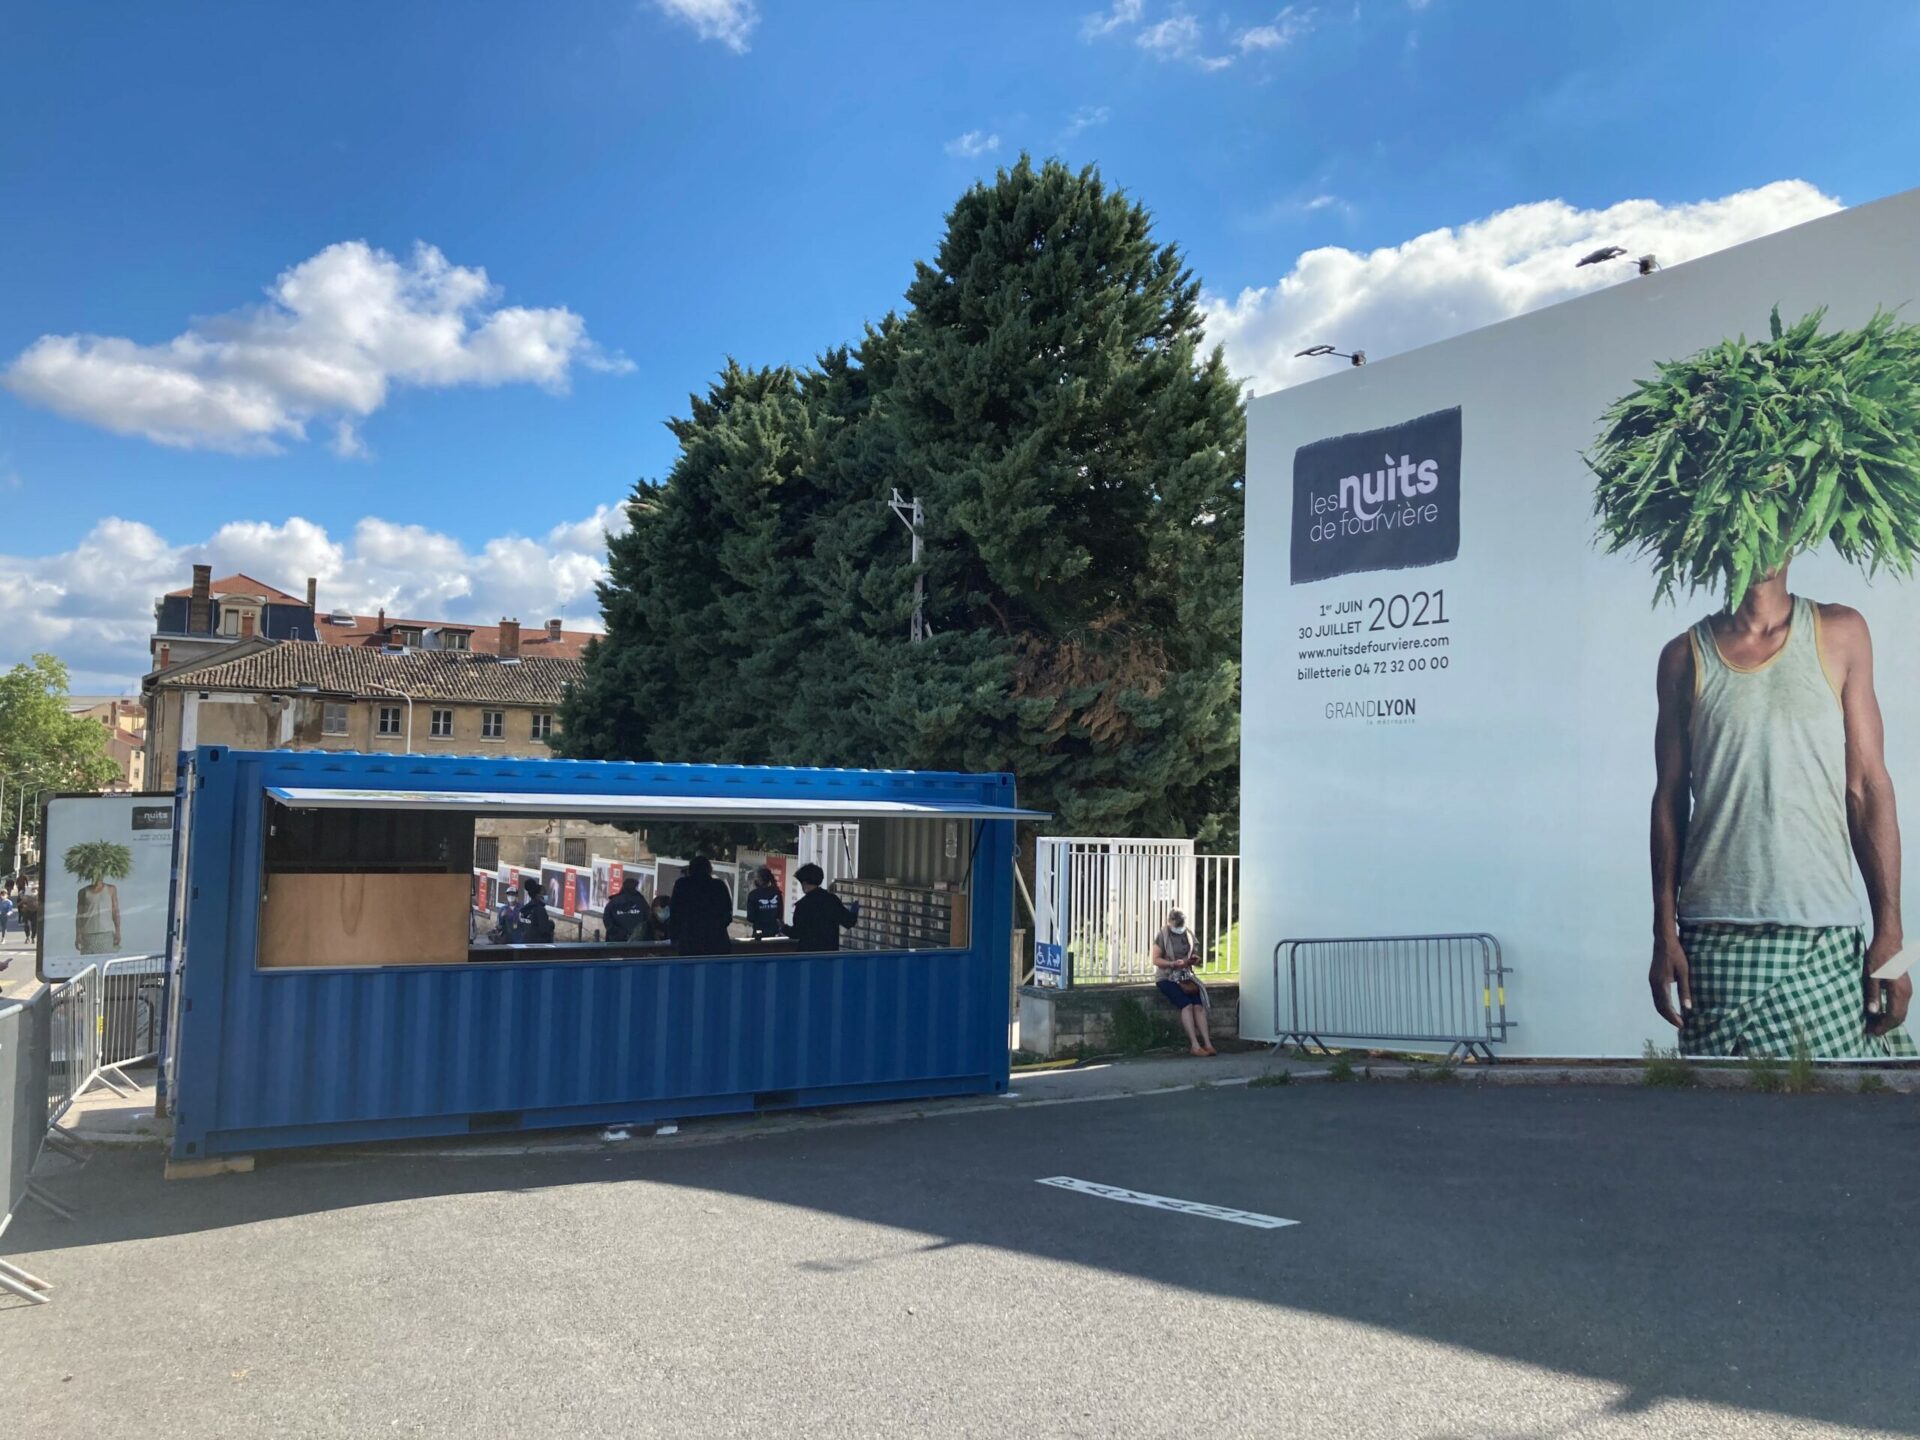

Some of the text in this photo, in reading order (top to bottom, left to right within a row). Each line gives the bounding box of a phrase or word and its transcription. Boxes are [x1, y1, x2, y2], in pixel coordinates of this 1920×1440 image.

[1310, 491, 1339, 517] les
[1309, 501, 1438, 542] de fourvière
[1334, 599, 1363, 615] JUIN
[1368, 588, 1450, 632] 2021
[1298, 620, 1362, 640] 30 JUILLET
[1298, 636, 1450, 659] www.nuitsdefourviere.com
[1297, 655, 1449, 681] billetterie 04 72 32 00 00
